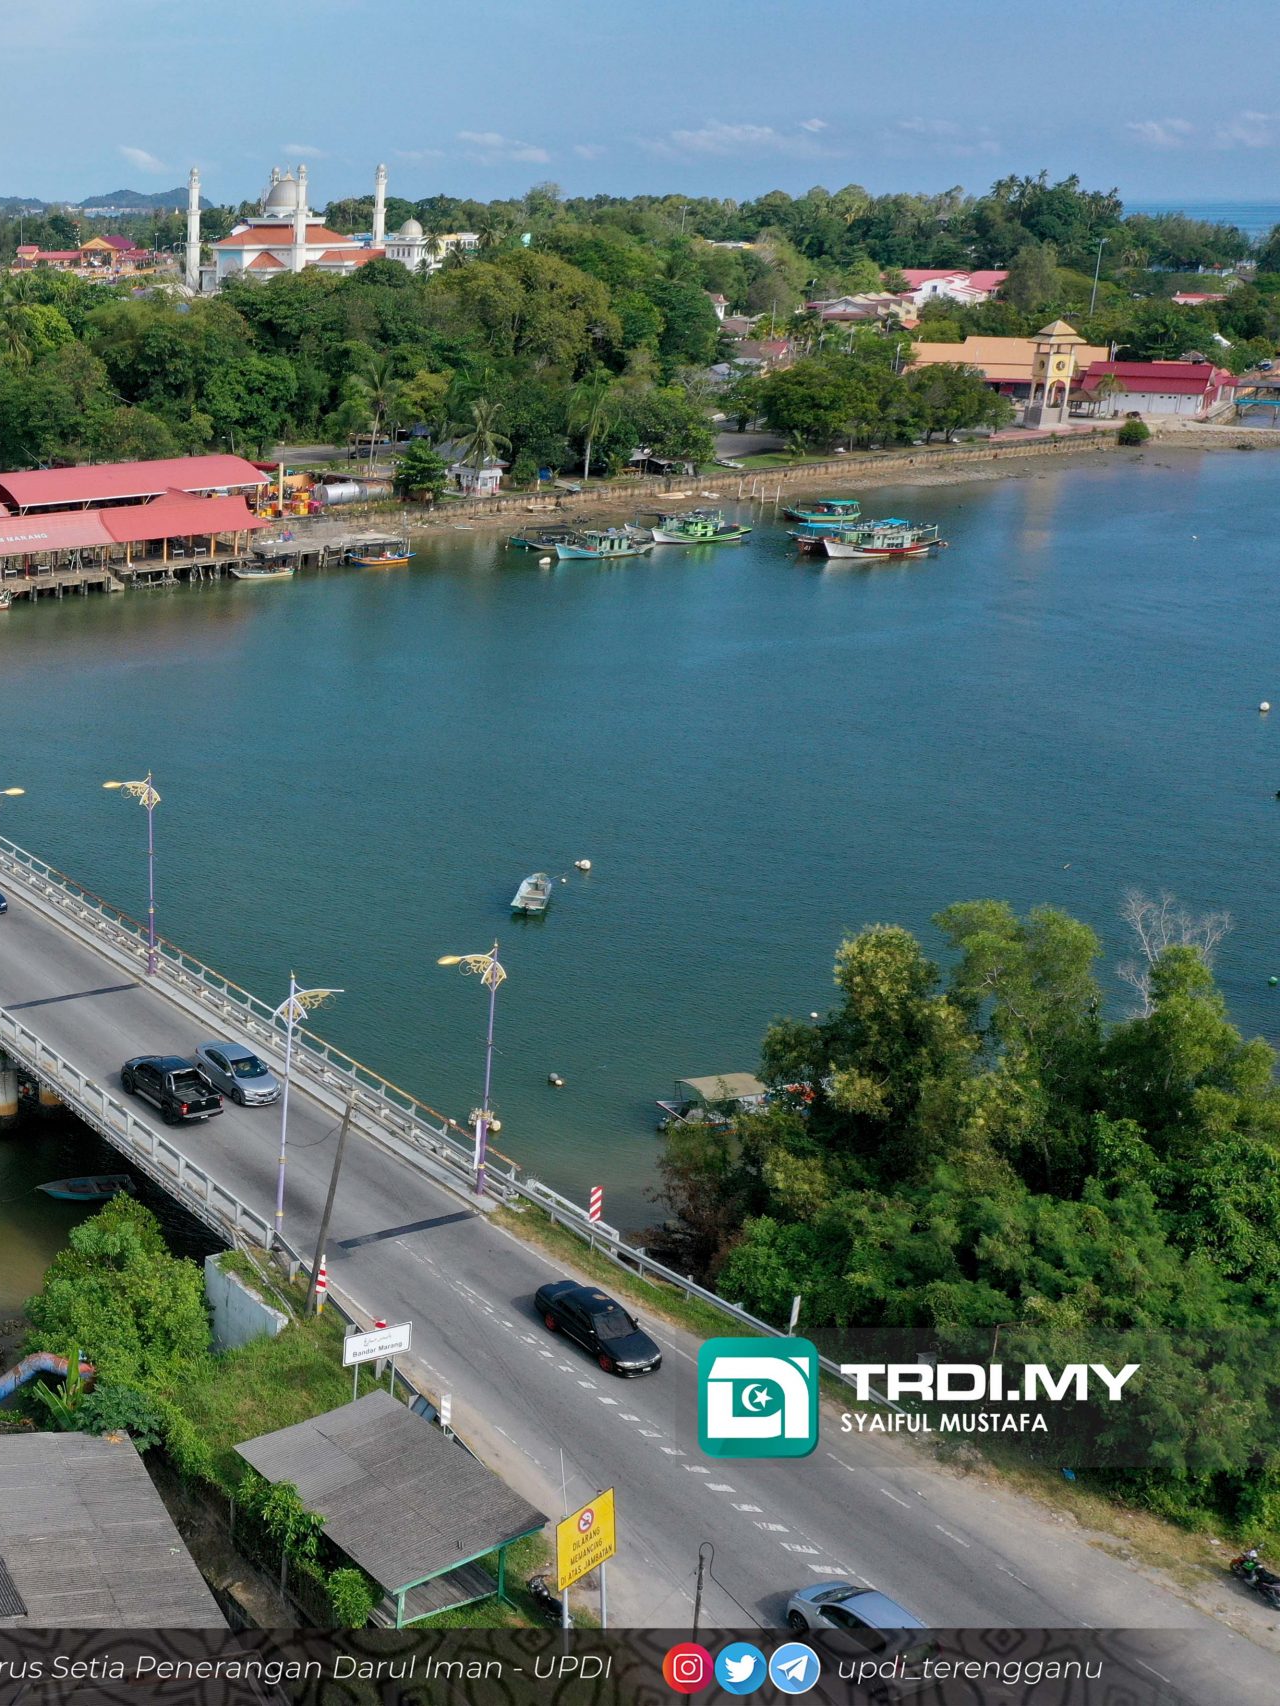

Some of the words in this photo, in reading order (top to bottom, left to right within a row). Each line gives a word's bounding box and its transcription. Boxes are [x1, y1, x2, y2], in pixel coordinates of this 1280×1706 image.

[7, 533, 48, 542] MARANG
[353, 1348, 376, 1357] Bandar
[378, 1342, 402, 1350] Marang
[573, 1527, 600, 1551] DILARANG
[571, 1538, 602, 1565] MEMANCING
[561, 1576, 566, 1585] DI
[568, 1566, 581, 1579] ATAS
[584, 1544, 612, 1569] JAMBATAN
